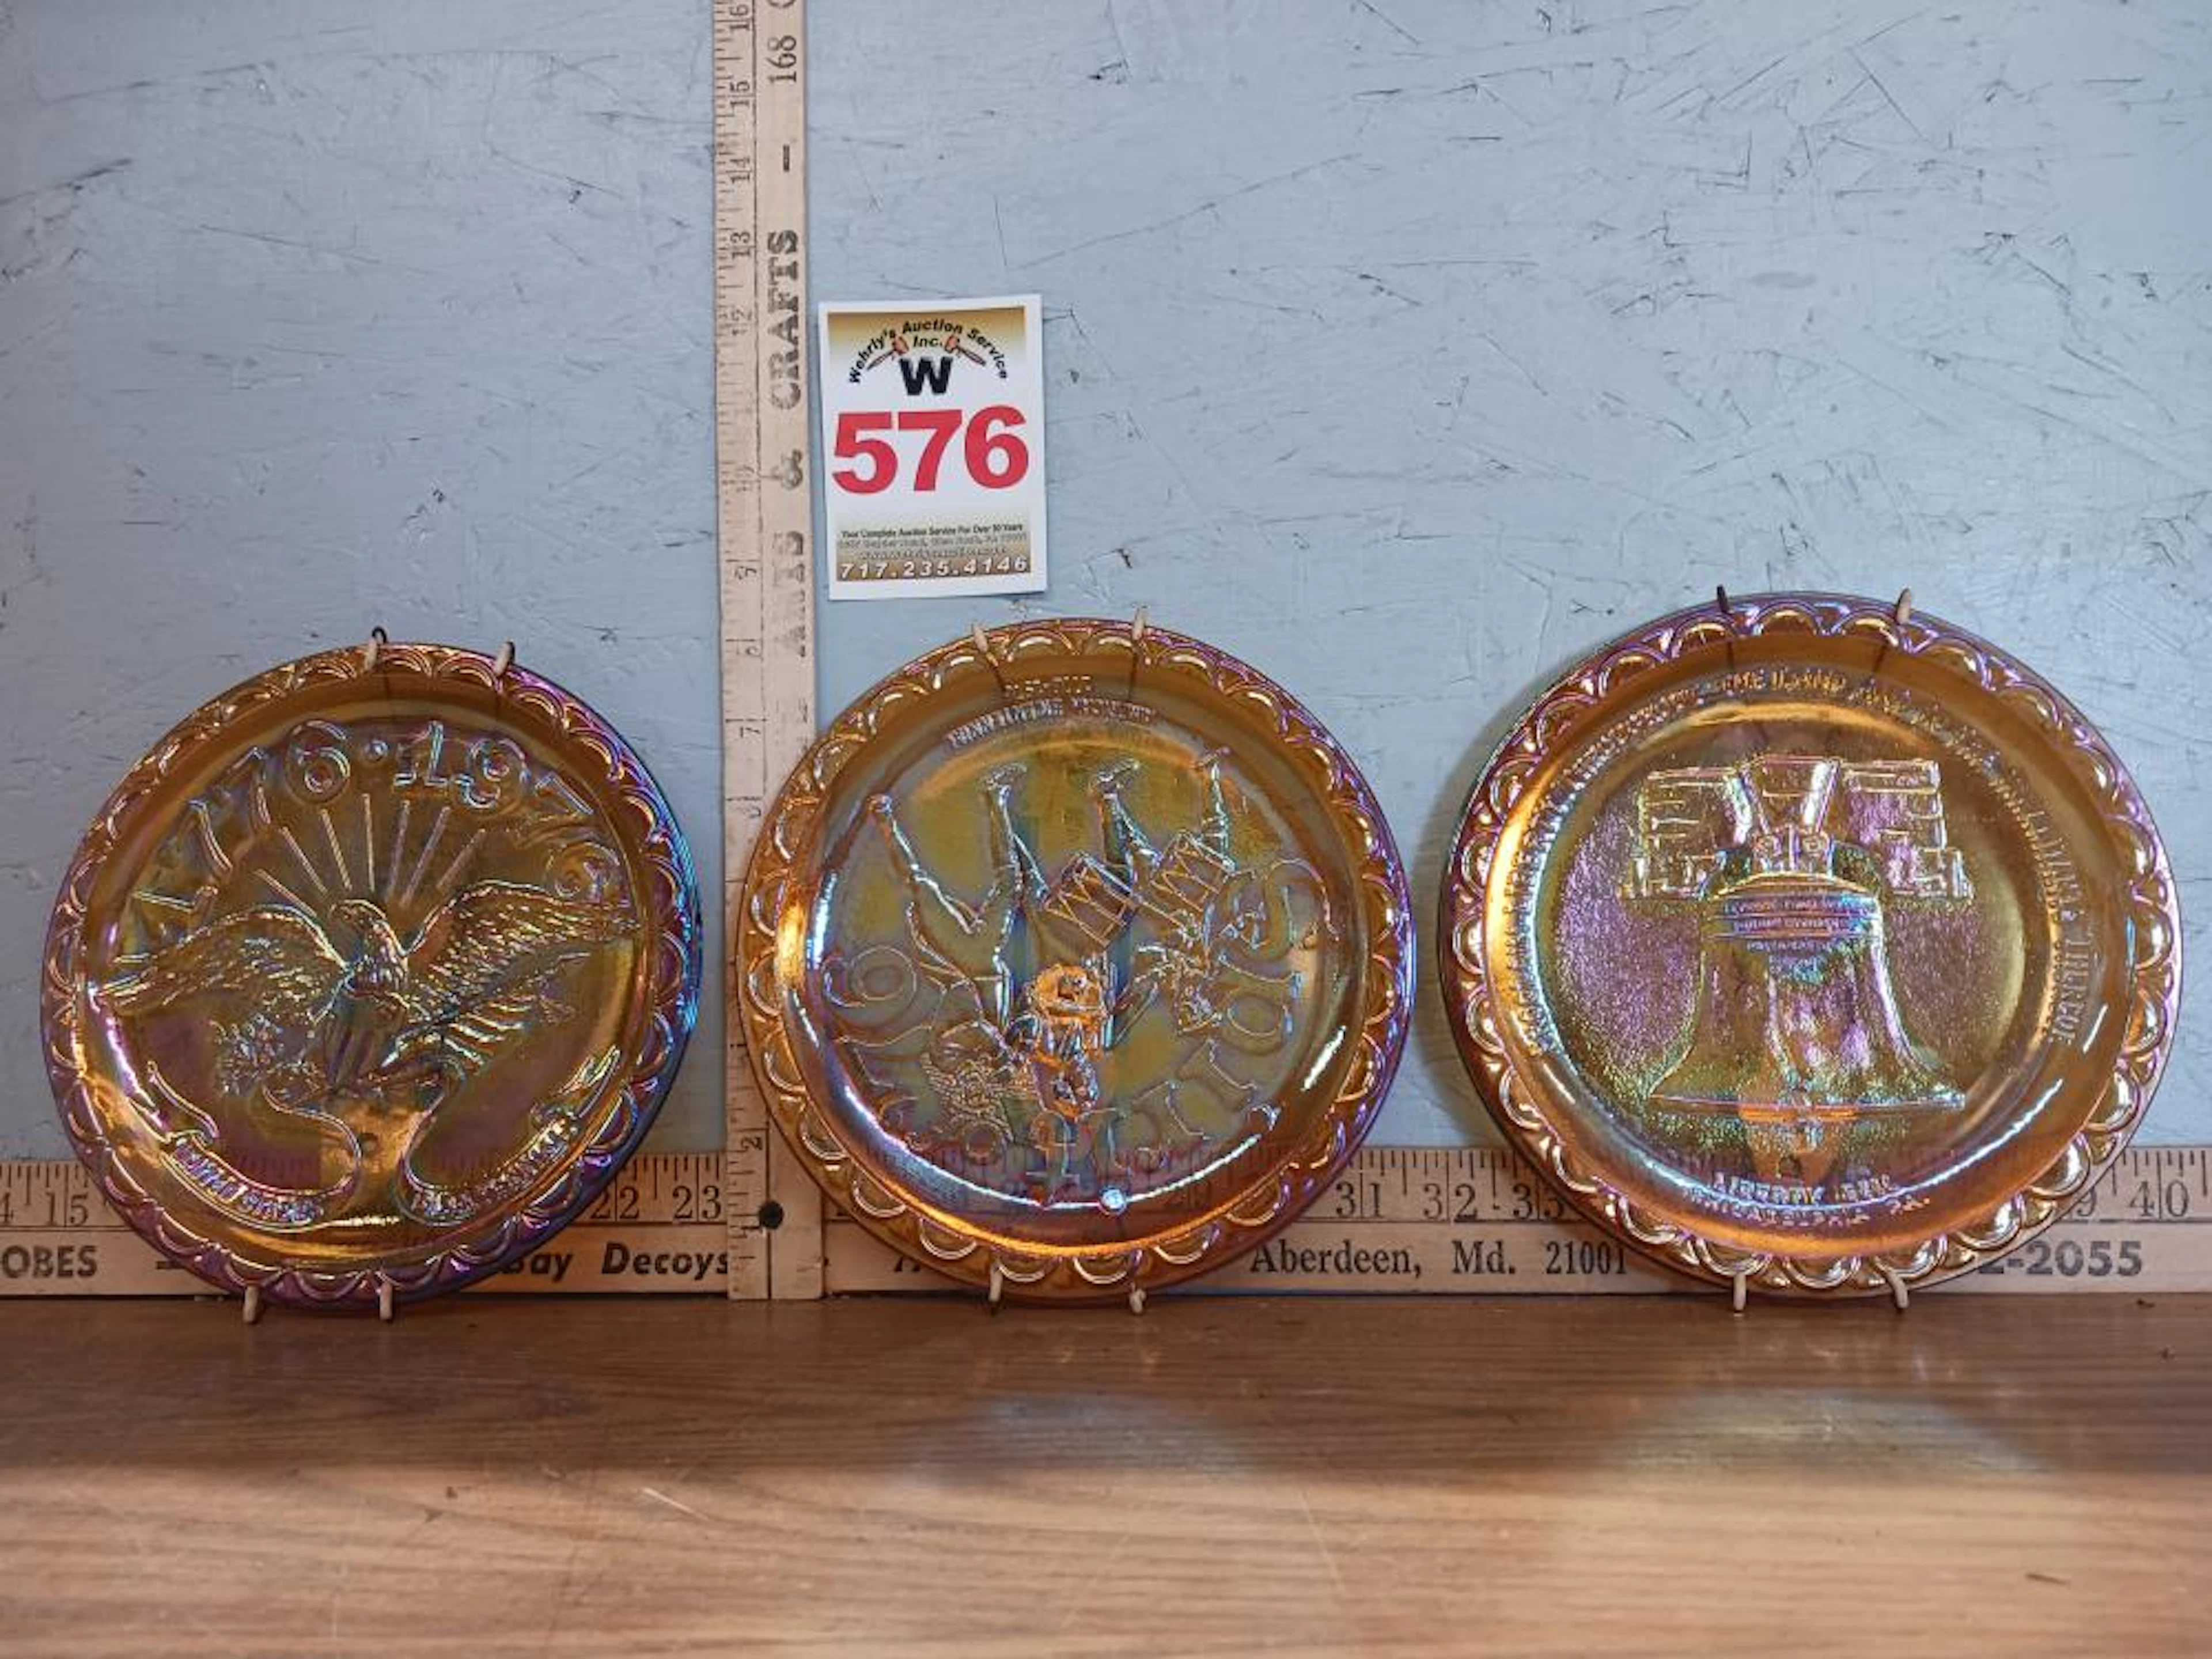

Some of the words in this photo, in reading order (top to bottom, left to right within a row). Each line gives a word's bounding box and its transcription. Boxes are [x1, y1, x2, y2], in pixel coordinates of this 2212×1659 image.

[768, 35, 798, 84] 168
[729, 80, 750, 108] 15
[730, 156, 751, 184] 14
[730, 230, 751, 260] 13
[767, 229, 802, 410] CRAFTS
[849, 328, 896, 384] Wehrly's
[902, 318, 963, 335] Auction
[967, 328, 1008, 378] Service
[912, 336, 943, 347] Inc.
[899, 356, 953, 396] W
[831, 405, 1029, 494] 576
[899, 527, 926, 536] Auction
[929, 525, 956, 536] Service
[973, 524, 991, 533] Over
[840, 555, 1028, 579] 717.235.4146
[46, 1191, 89, 1226] 15
[672, 1185, 721, 1219] 23
[1335, 1182, 1381, 1219] 31
[1423, 1182, 1478, 1222] 32
[2131, 1180, 2189, 1217] 40
[601, 1241, 728, 1281] Decoys
[1249, 1238, 1422, 1279] Aberdeen,
[1451, 1238, 1516, 1275] Md.
[1546, 1240, 1628, 1275] 21001
